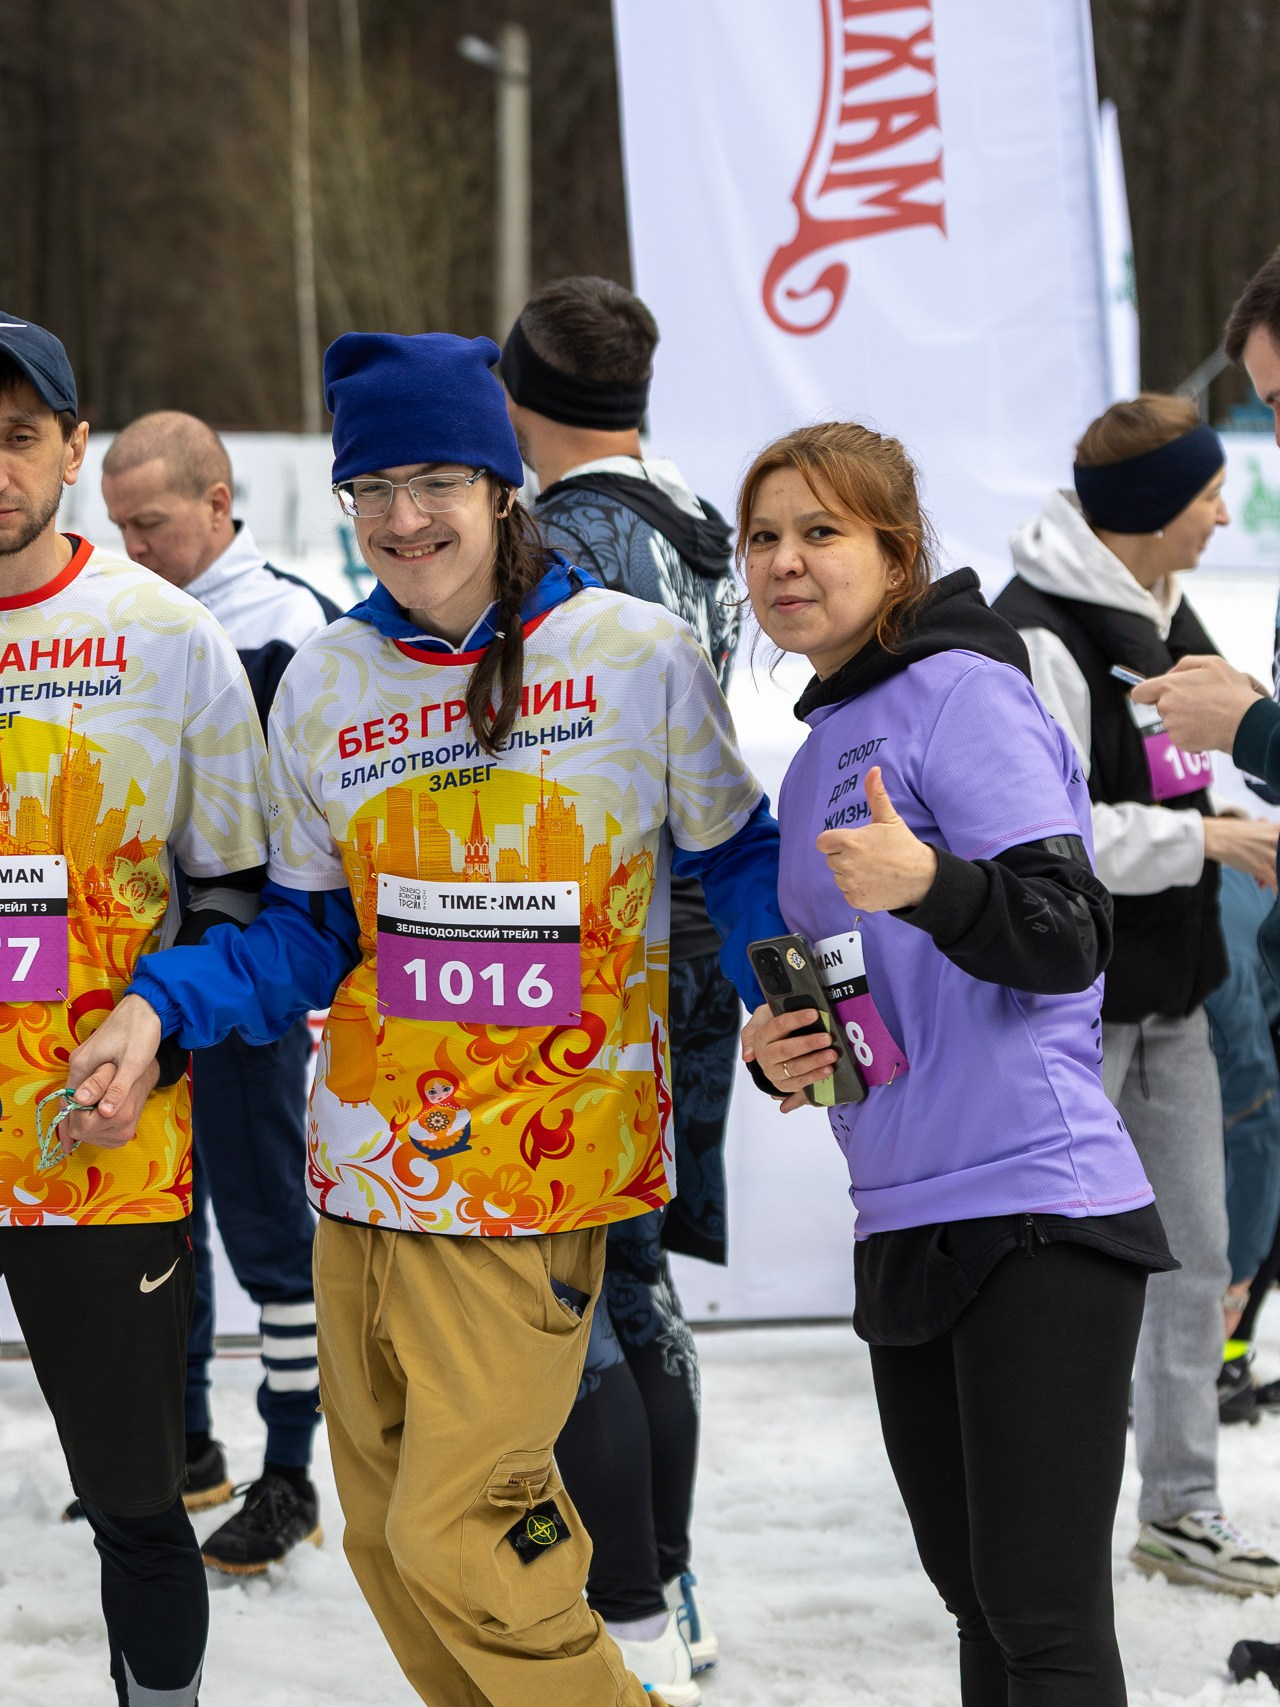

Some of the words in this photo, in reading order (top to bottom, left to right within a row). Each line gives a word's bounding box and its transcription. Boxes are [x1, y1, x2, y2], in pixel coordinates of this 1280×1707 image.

[760, 0, 948, 338] МАХ
[338, 712, 409, 760] БЕЗ
[340, 716, 594, 790] БЛАГОТВОРИЛЬНЫЙ
[429, 763, 498, 792] ЗАБЕГ
[823, 801, 872, 832] жизн
[396, 922, 500, 939] ЗЕЛЕНОДОЛЬСКИЙ
[502, 928, 538, 939] ТРЕЙЛ
[403, 958, 554, 1008] 1016
